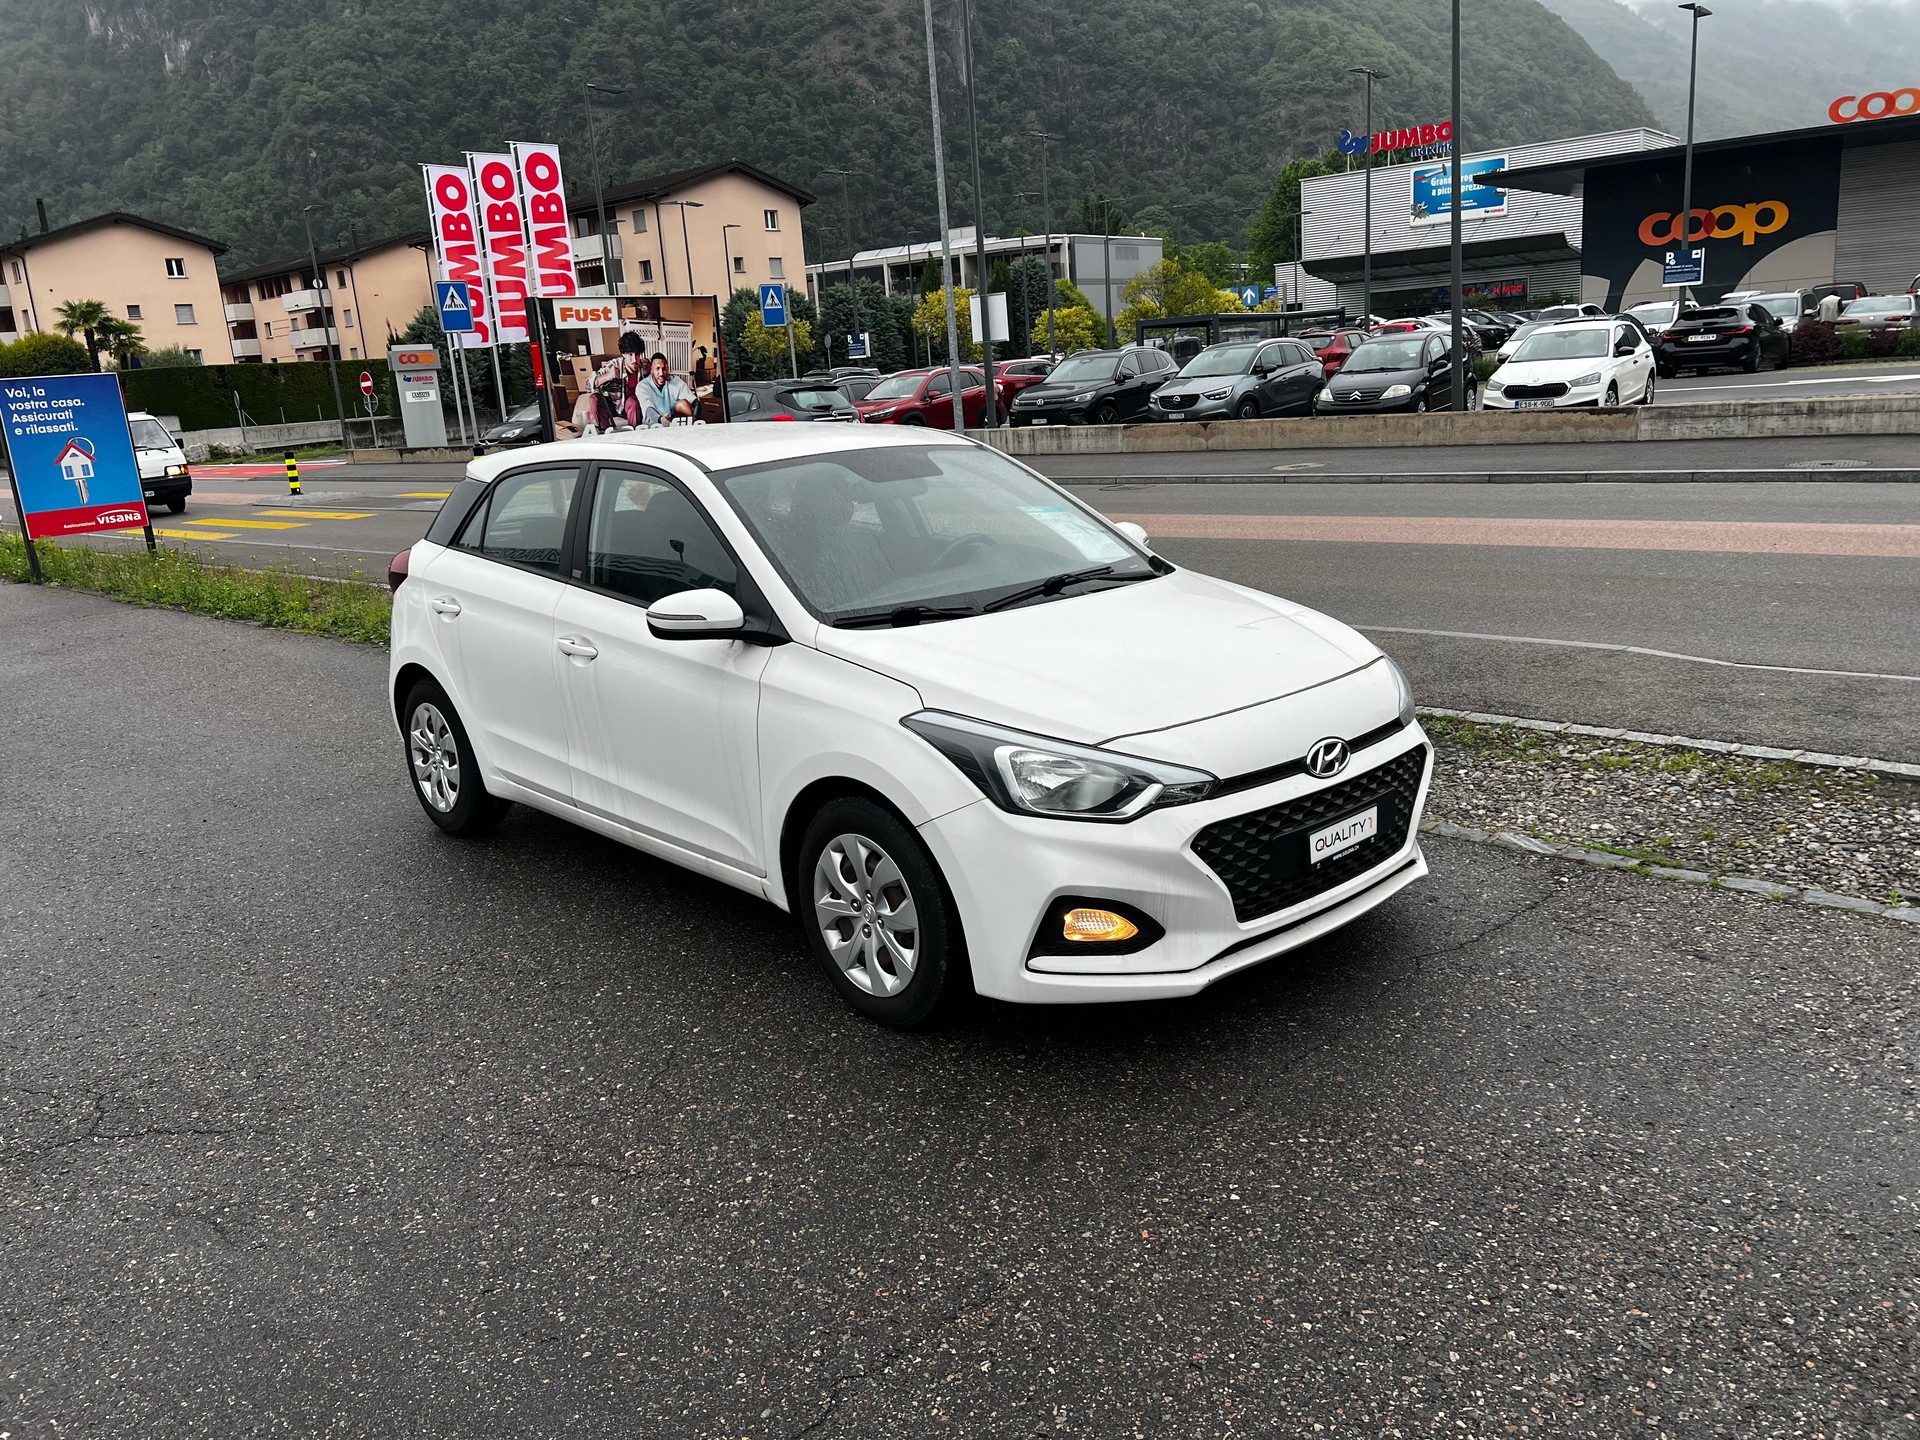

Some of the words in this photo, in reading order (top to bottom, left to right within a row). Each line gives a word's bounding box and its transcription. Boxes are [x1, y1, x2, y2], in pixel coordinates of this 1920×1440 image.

[1828, 87, 1920, 124] coo
[1370, 121, 1452, 153] JUMBO
[1430, 175, 1452, 187] Grand
[1431, 189, 1437, 197] a
[525, 152, 577, 297] UMBO
[1638, 200, 1790, 246] coop
[481, 161, 530, 338] JUMBO
[559, 306, 613, 323] Fust
[398, 353, 436, 366] coop
[5, 387, 31, 399] Voi,
[32, 386, 46, 397] la
[8, 400, 48, 411] vostra
[51, 397, 85, 408] casa.
[12, 409, 74, 424] Assicurati
[15, 427, 23, 436] e
[26, 422, 79, 435] rilassati.
[63, 520, 96, 529] Assicurazioni
